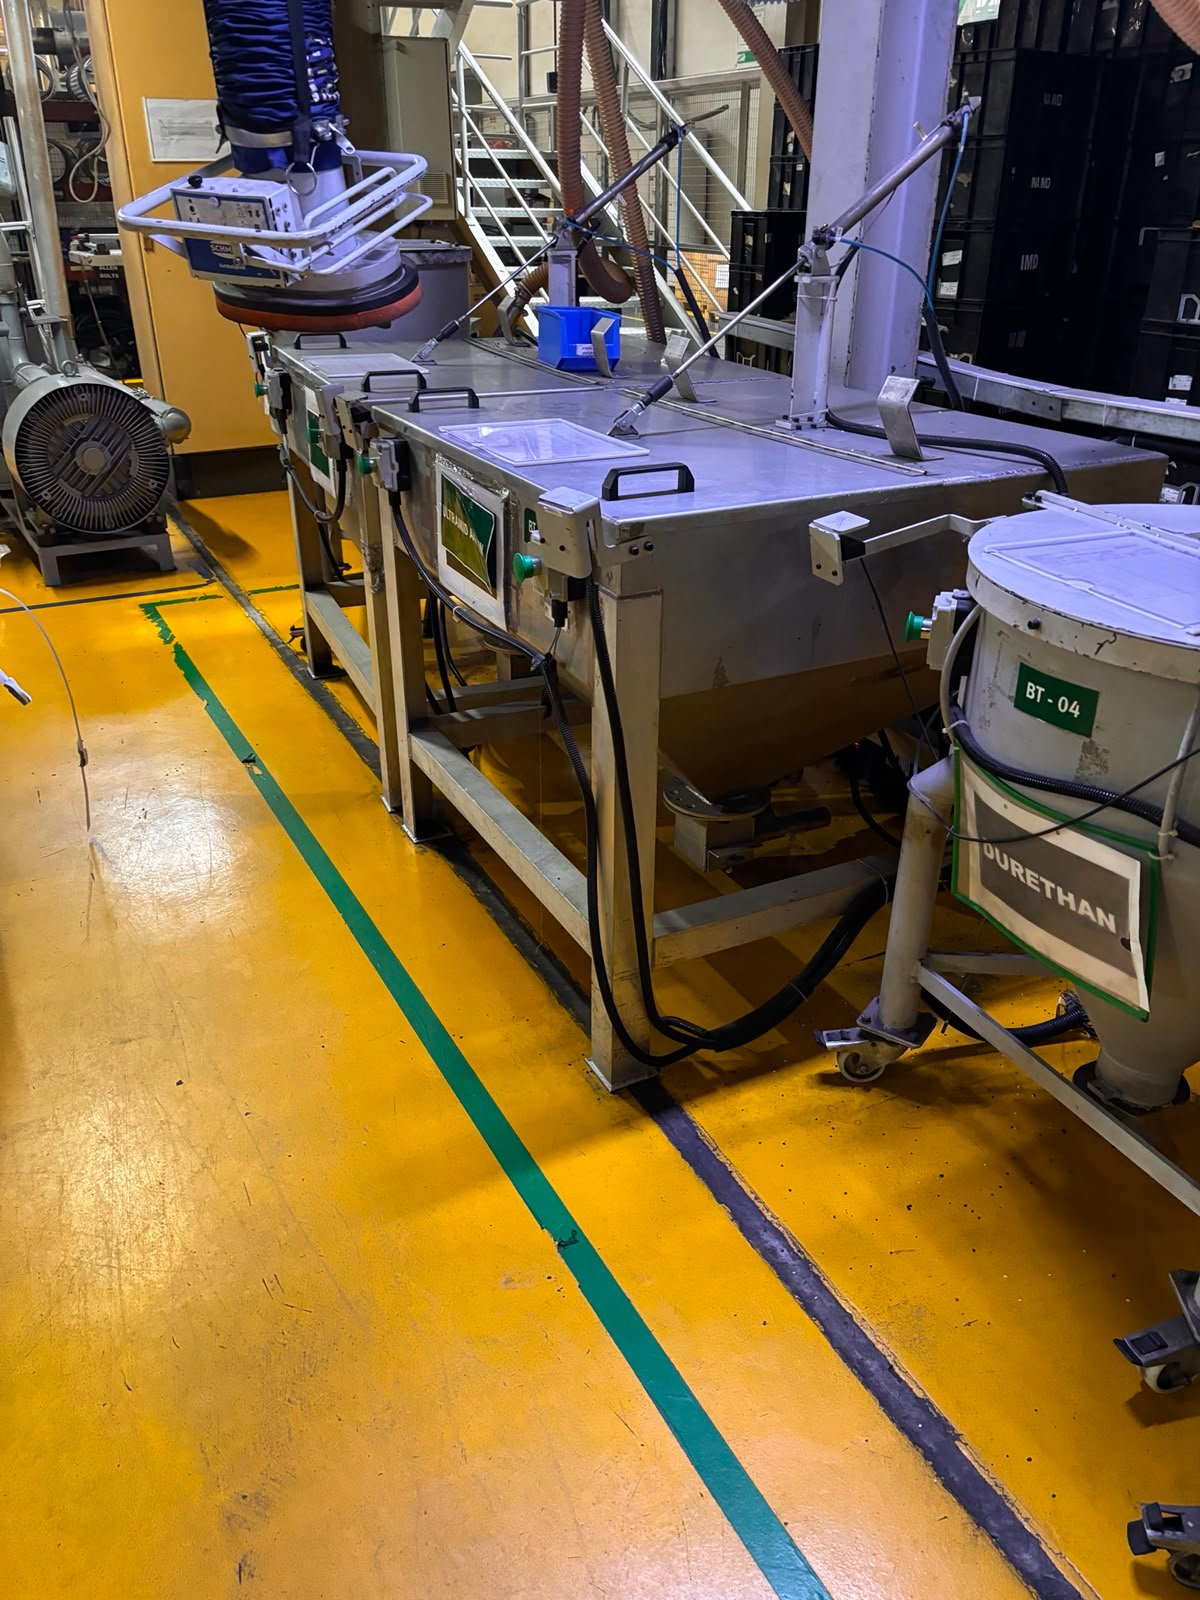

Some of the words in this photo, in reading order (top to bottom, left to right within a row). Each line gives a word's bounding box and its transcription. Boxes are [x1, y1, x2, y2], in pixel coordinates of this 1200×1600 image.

[1026, 681, 1045, 703] BT
[1057, 696, 1080, 718] 04
[982, 838, 1117, 934] DURETHAN
